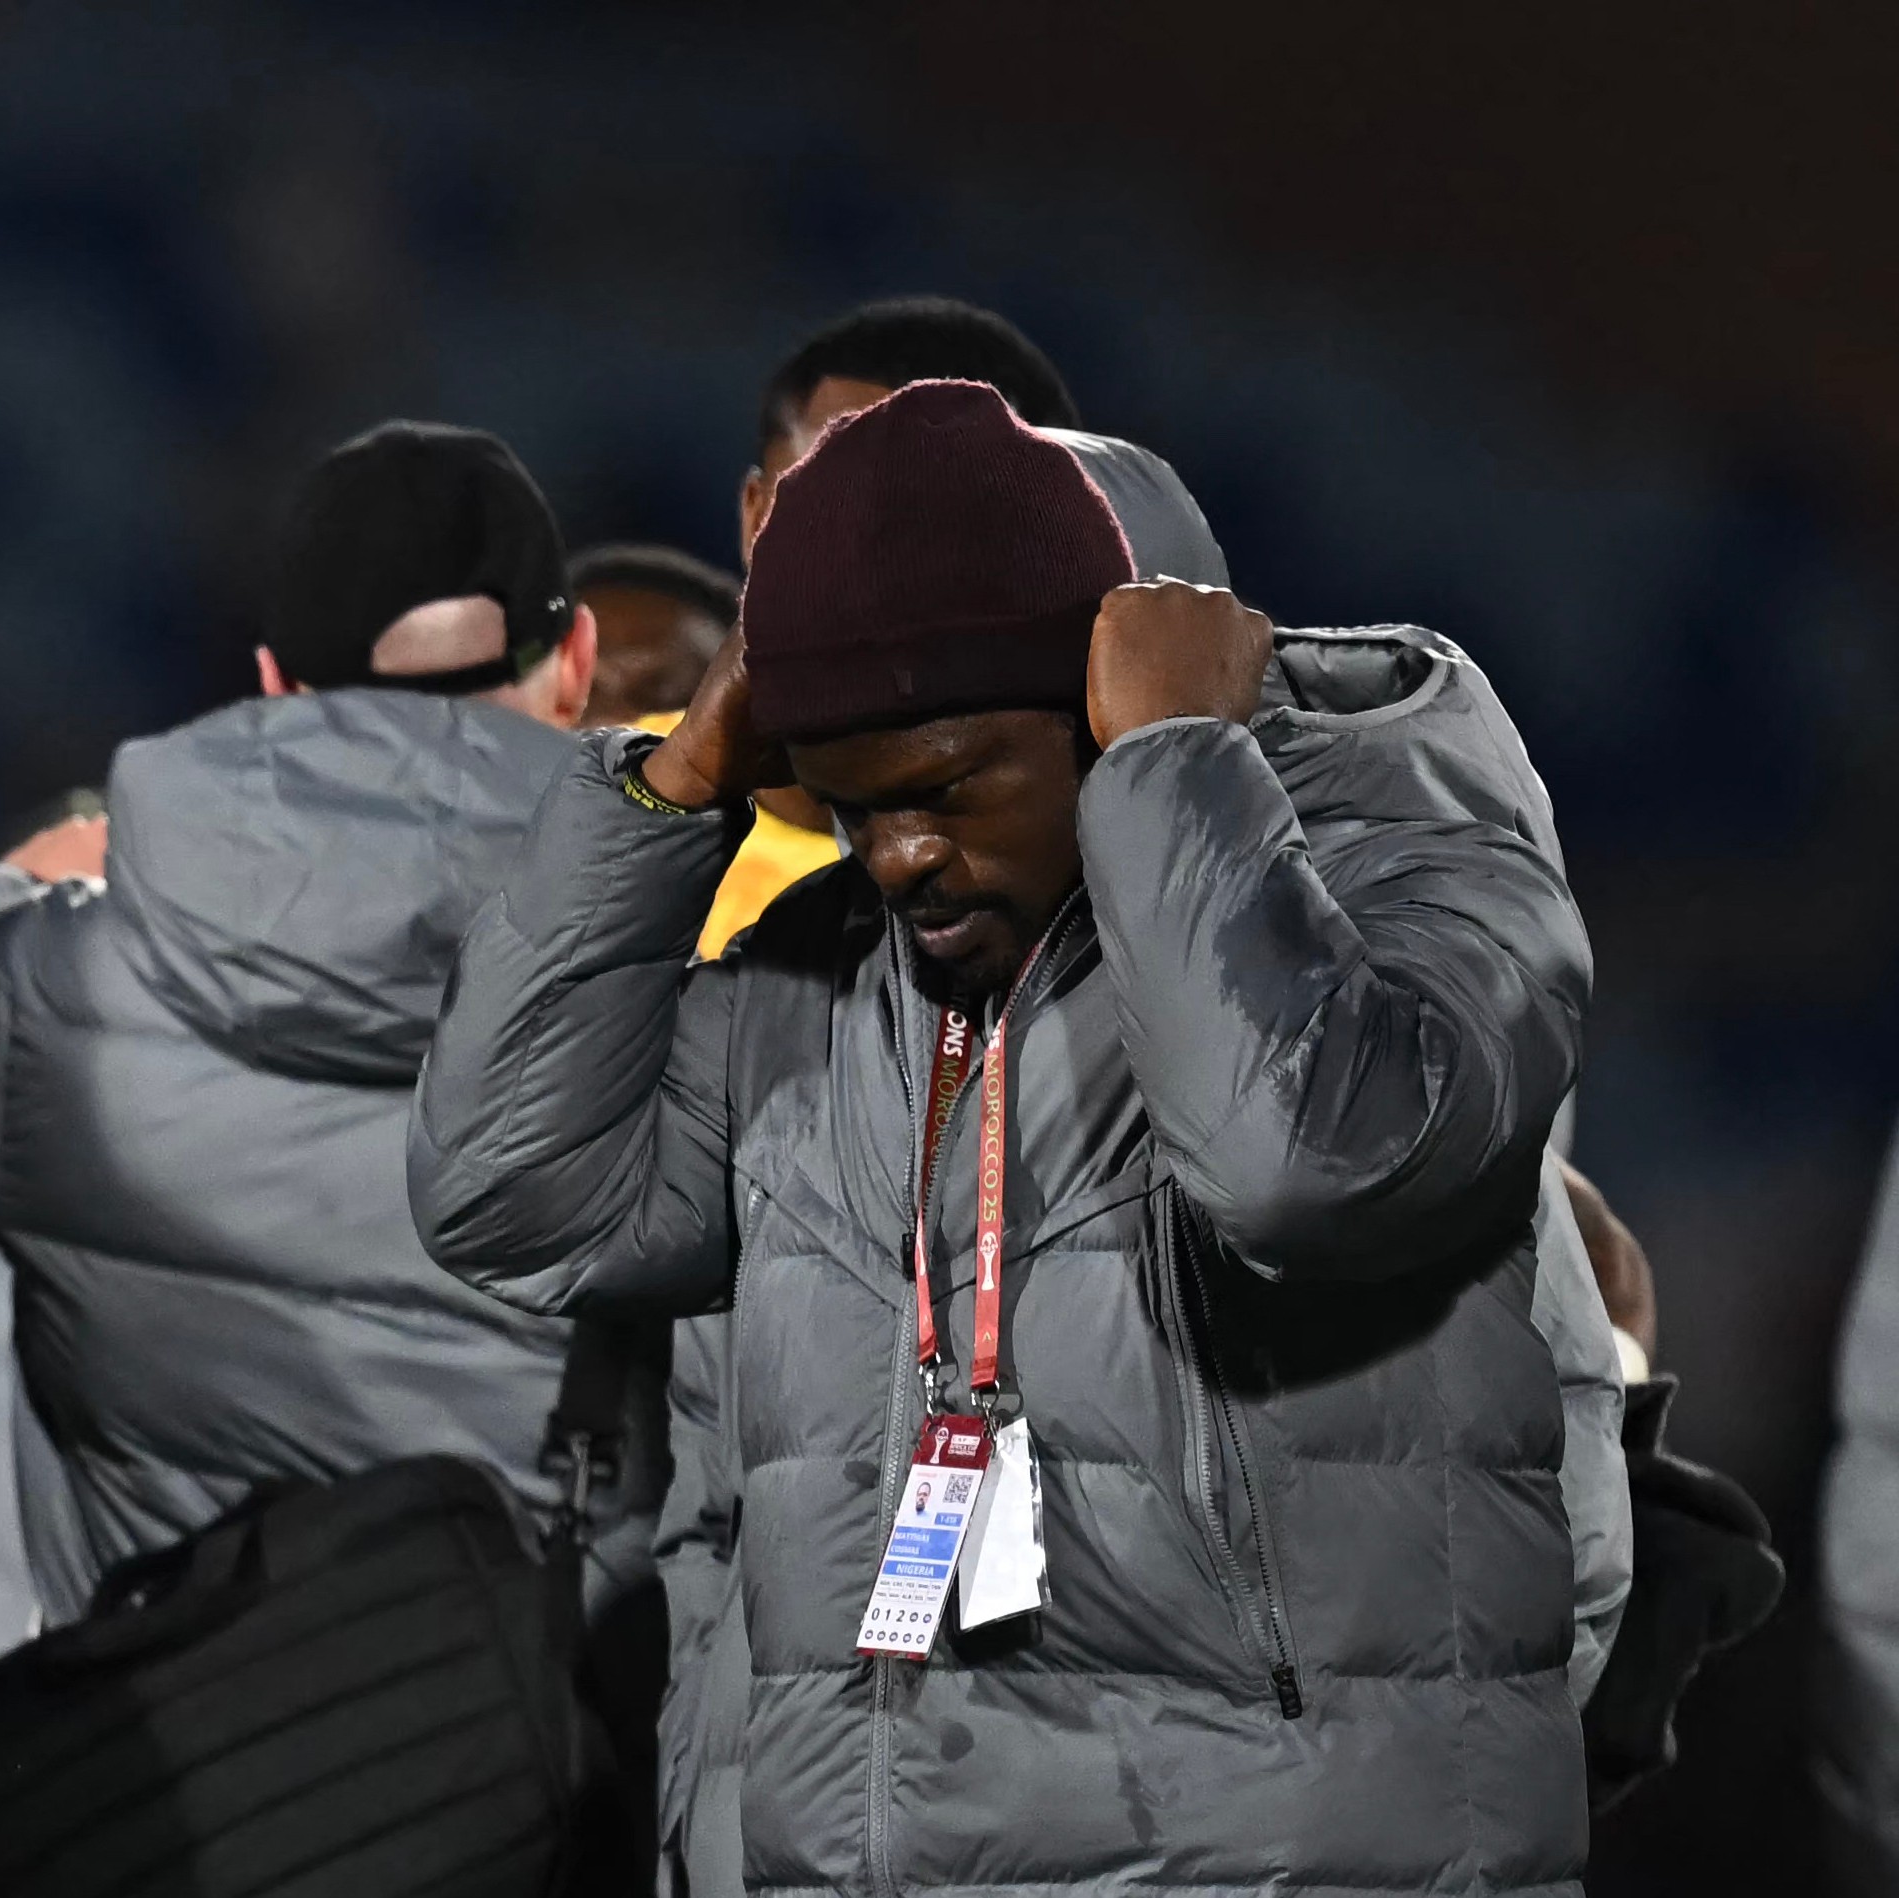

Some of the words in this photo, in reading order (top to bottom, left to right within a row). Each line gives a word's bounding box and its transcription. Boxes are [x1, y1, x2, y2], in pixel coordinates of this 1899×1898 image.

[942, 1008, 968, 1058] ONS
[983, 1053, 1001, 1190] MOROCCO
[982, 1196, 999, 1223] 25
[896, 1563, 935, 1577] NIGERIA
[885, 1608, 892, 1621] 1
[895, 1609, 906, 1623] 2
